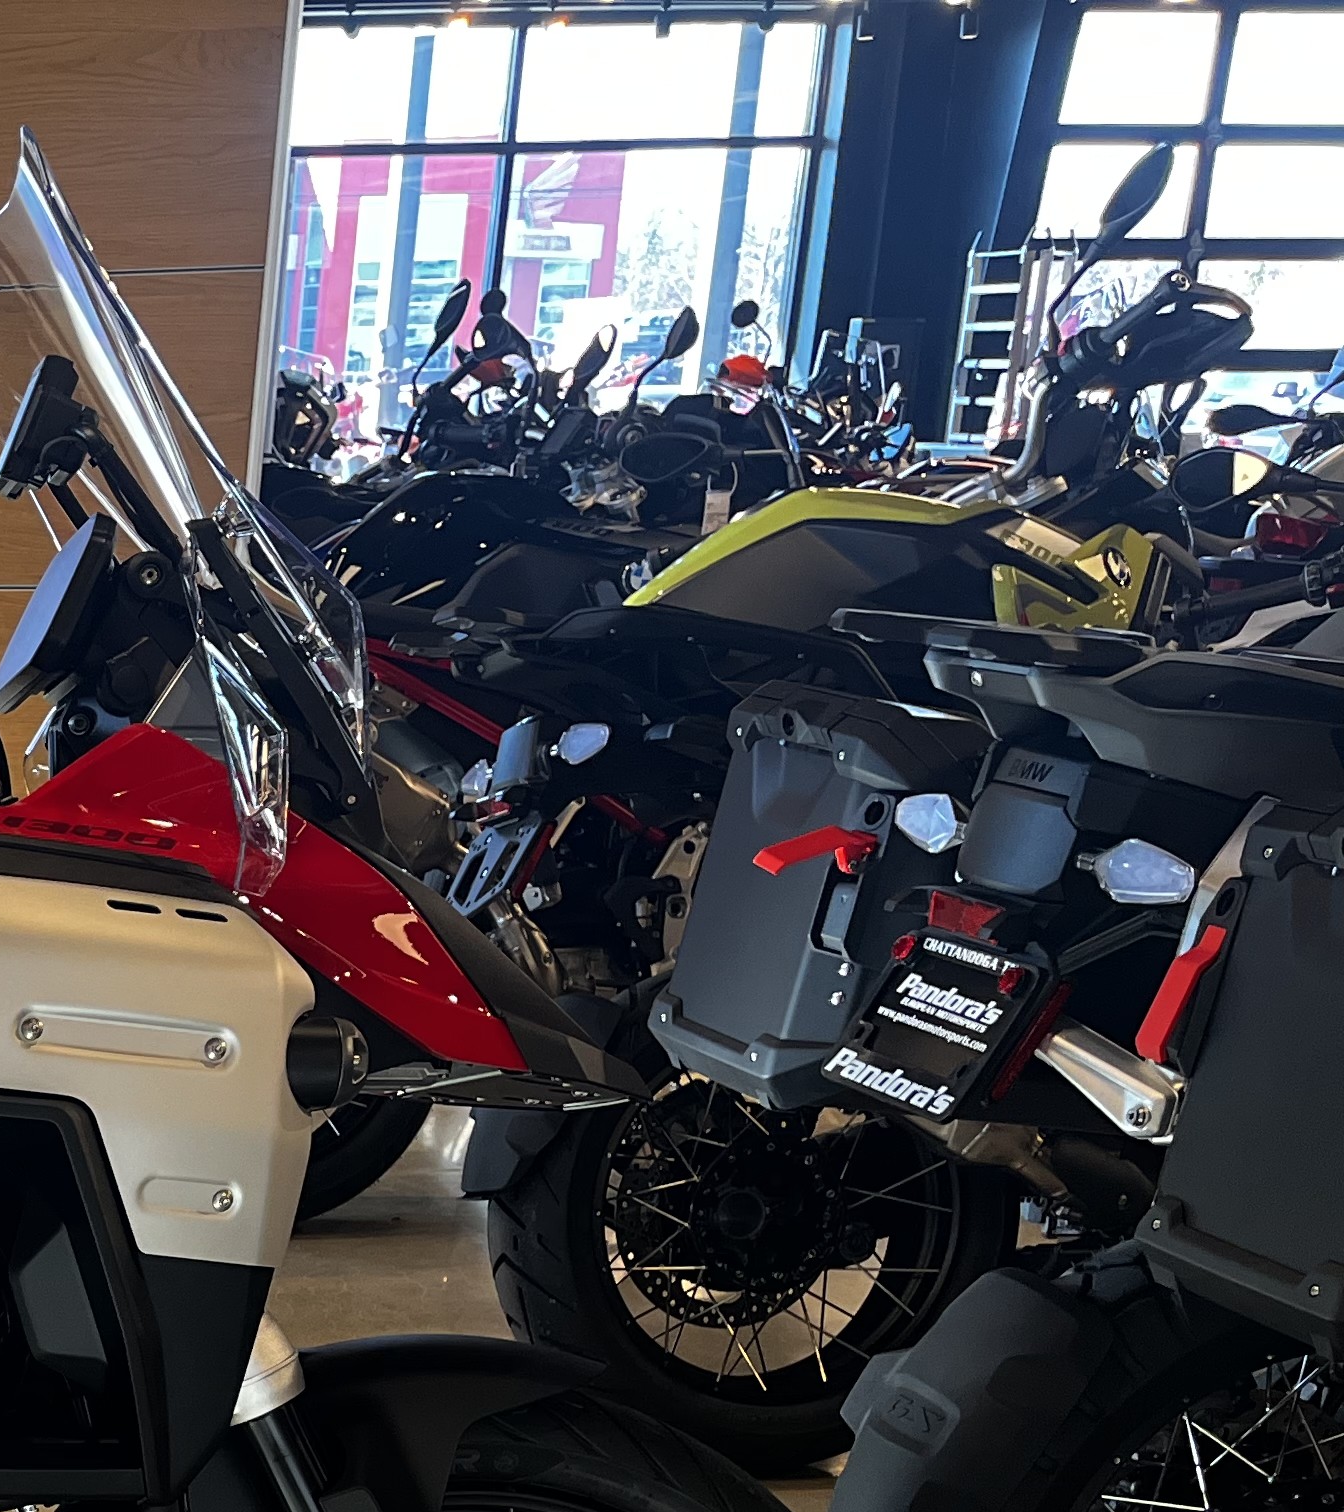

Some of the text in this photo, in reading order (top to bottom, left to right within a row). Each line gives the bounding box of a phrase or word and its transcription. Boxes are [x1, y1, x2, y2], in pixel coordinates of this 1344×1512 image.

[923, 937, 999, 971] CHATTANOOGA
[896, 972, 1004, 1026] Pandora's
[935, 1009, 988, 1033] MOTORSPORTS
[876, 1005, 988, 1053] www.pandorasmotorsports.com
[824, 1047, 955, 1115] Pandora's
